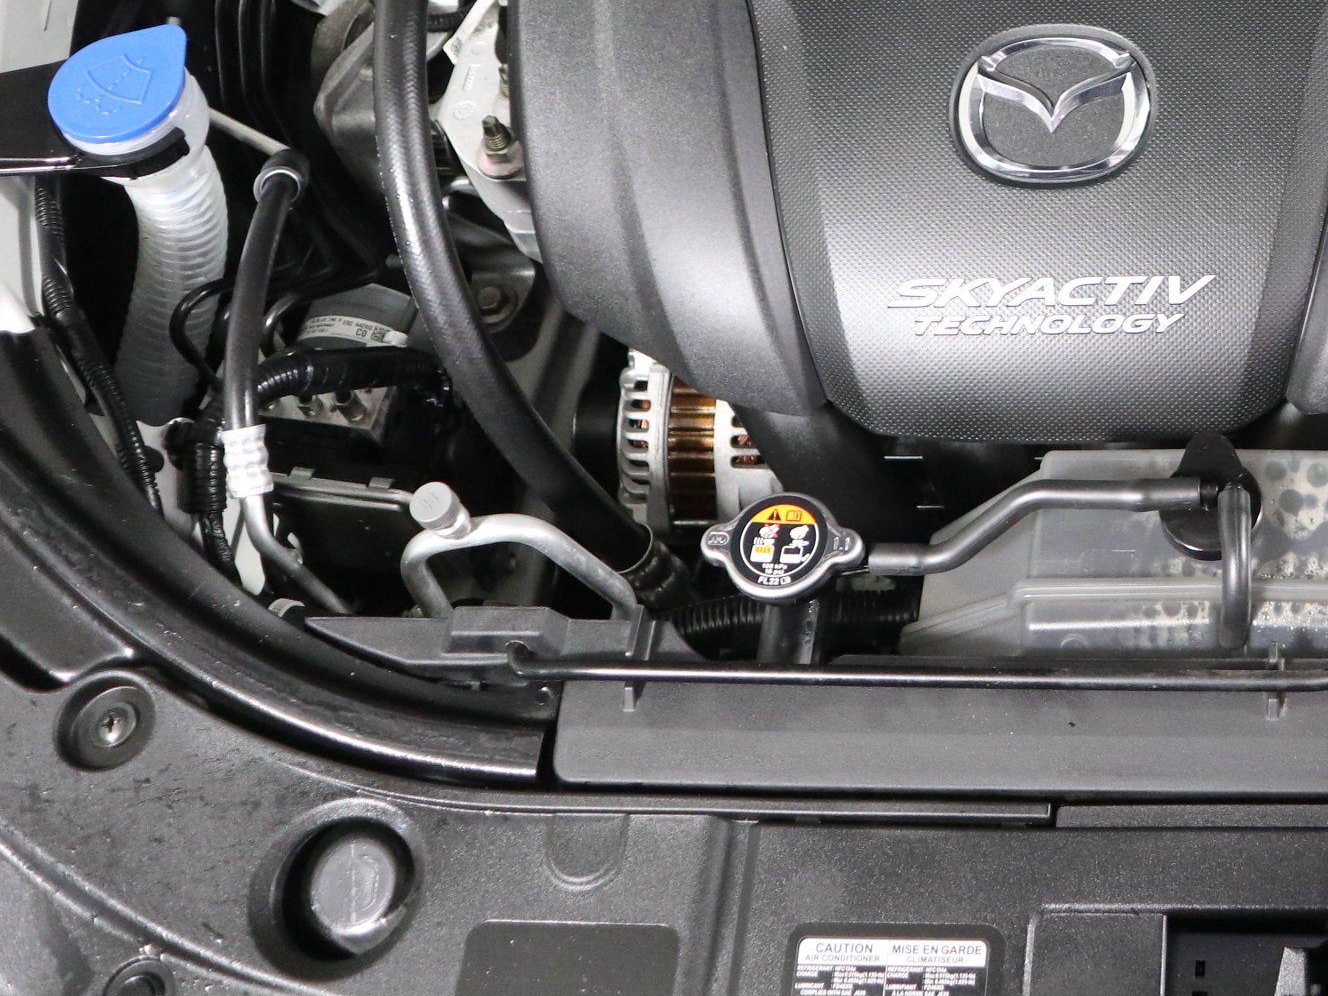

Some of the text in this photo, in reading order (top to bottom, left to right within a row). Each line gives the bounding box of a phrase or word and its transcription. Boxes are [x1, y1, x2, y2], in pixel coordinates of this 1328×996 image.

[887, 274, 1217, 309] SKYACTIV
[914, 313, 1186, 336] TECHNOLOGY
[757, 576, 780, 585] FL22
[816, 942, 873, 954] CAUTION
[892, 944, 982, 955] MISE EN GARDE
[822, 954, 880, 963] CONDITIONER
[906, 956, 964, 964] CLIMATISEUR
